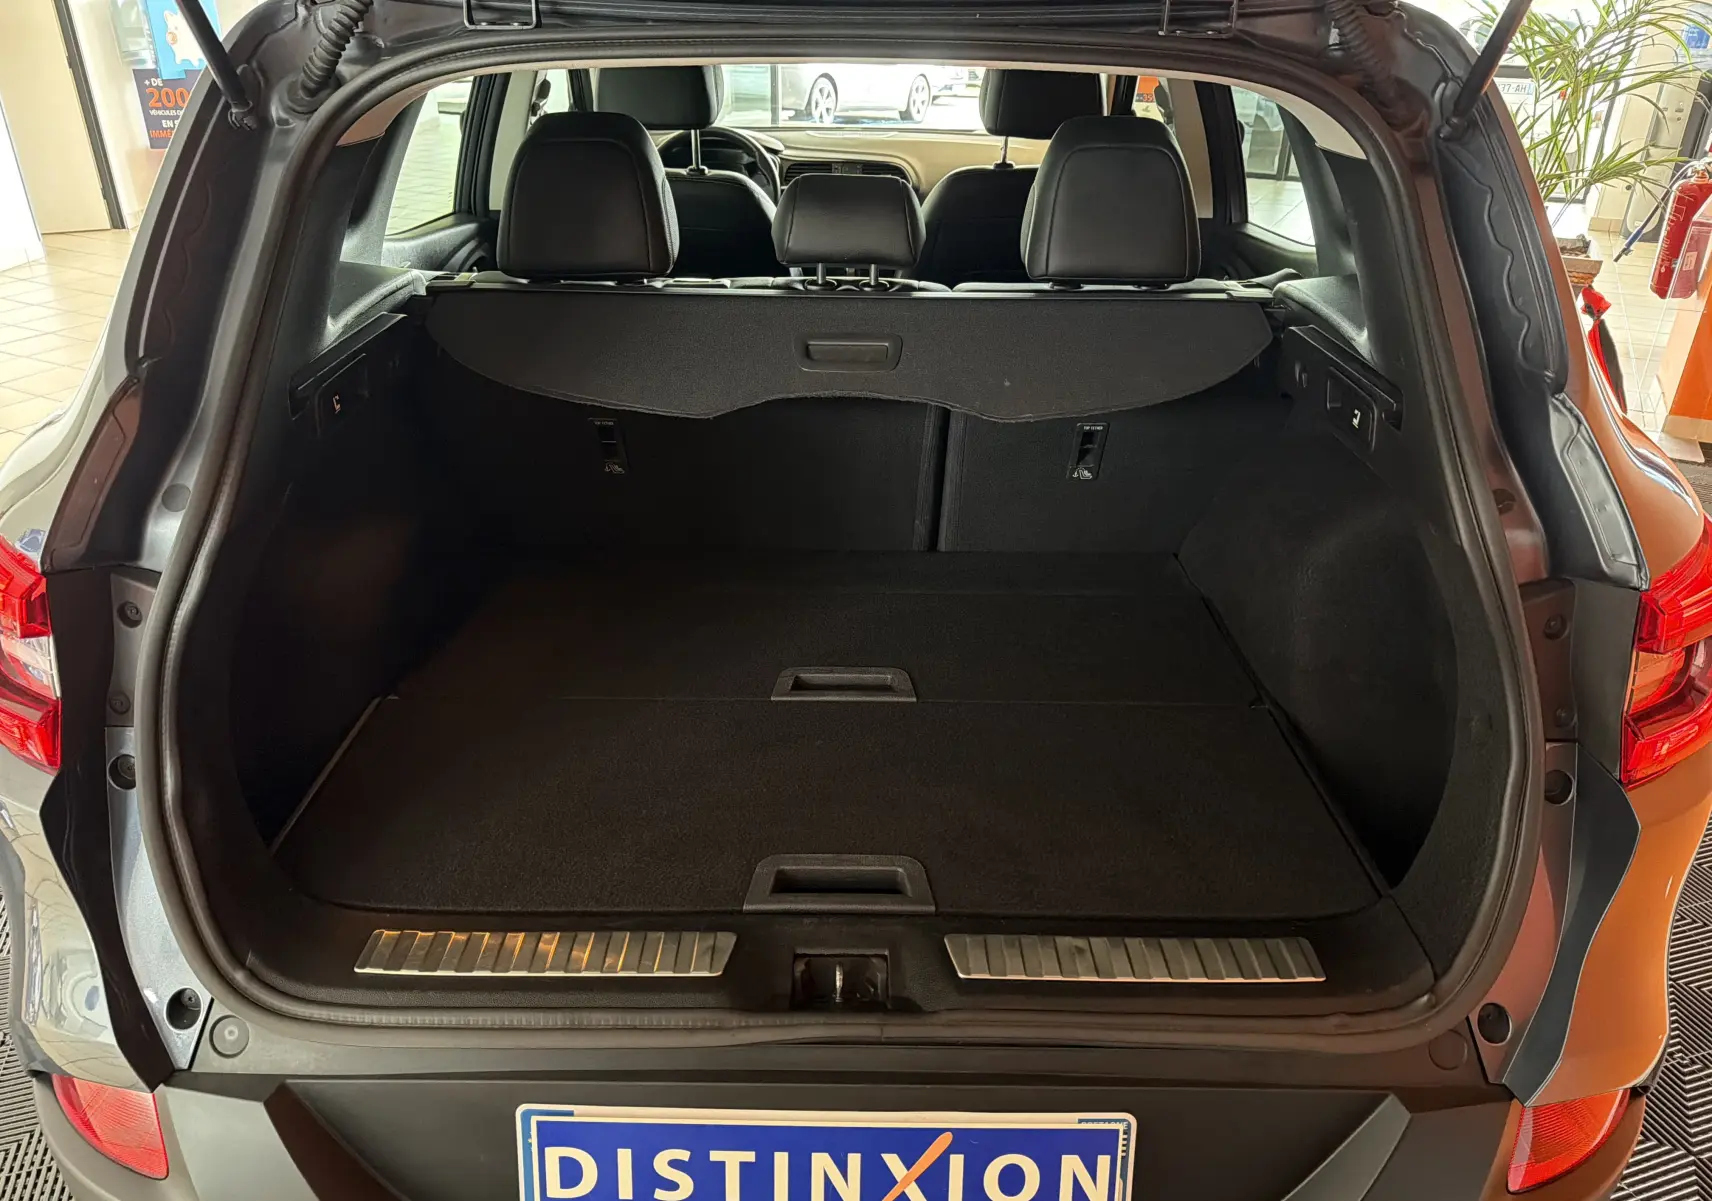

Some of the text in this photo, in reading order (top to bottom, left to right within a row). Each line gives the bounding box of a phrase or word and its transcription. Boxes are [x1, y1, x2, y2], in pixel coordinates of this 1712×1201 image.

[151, 77, 163, 87] DE
[145, 87, 191, 108] 200
[162, 119, 174, 128] EN
[149, 129, 175, 138] IMMÉ
[545, 1131, 1112, 1201] DISTINXION
